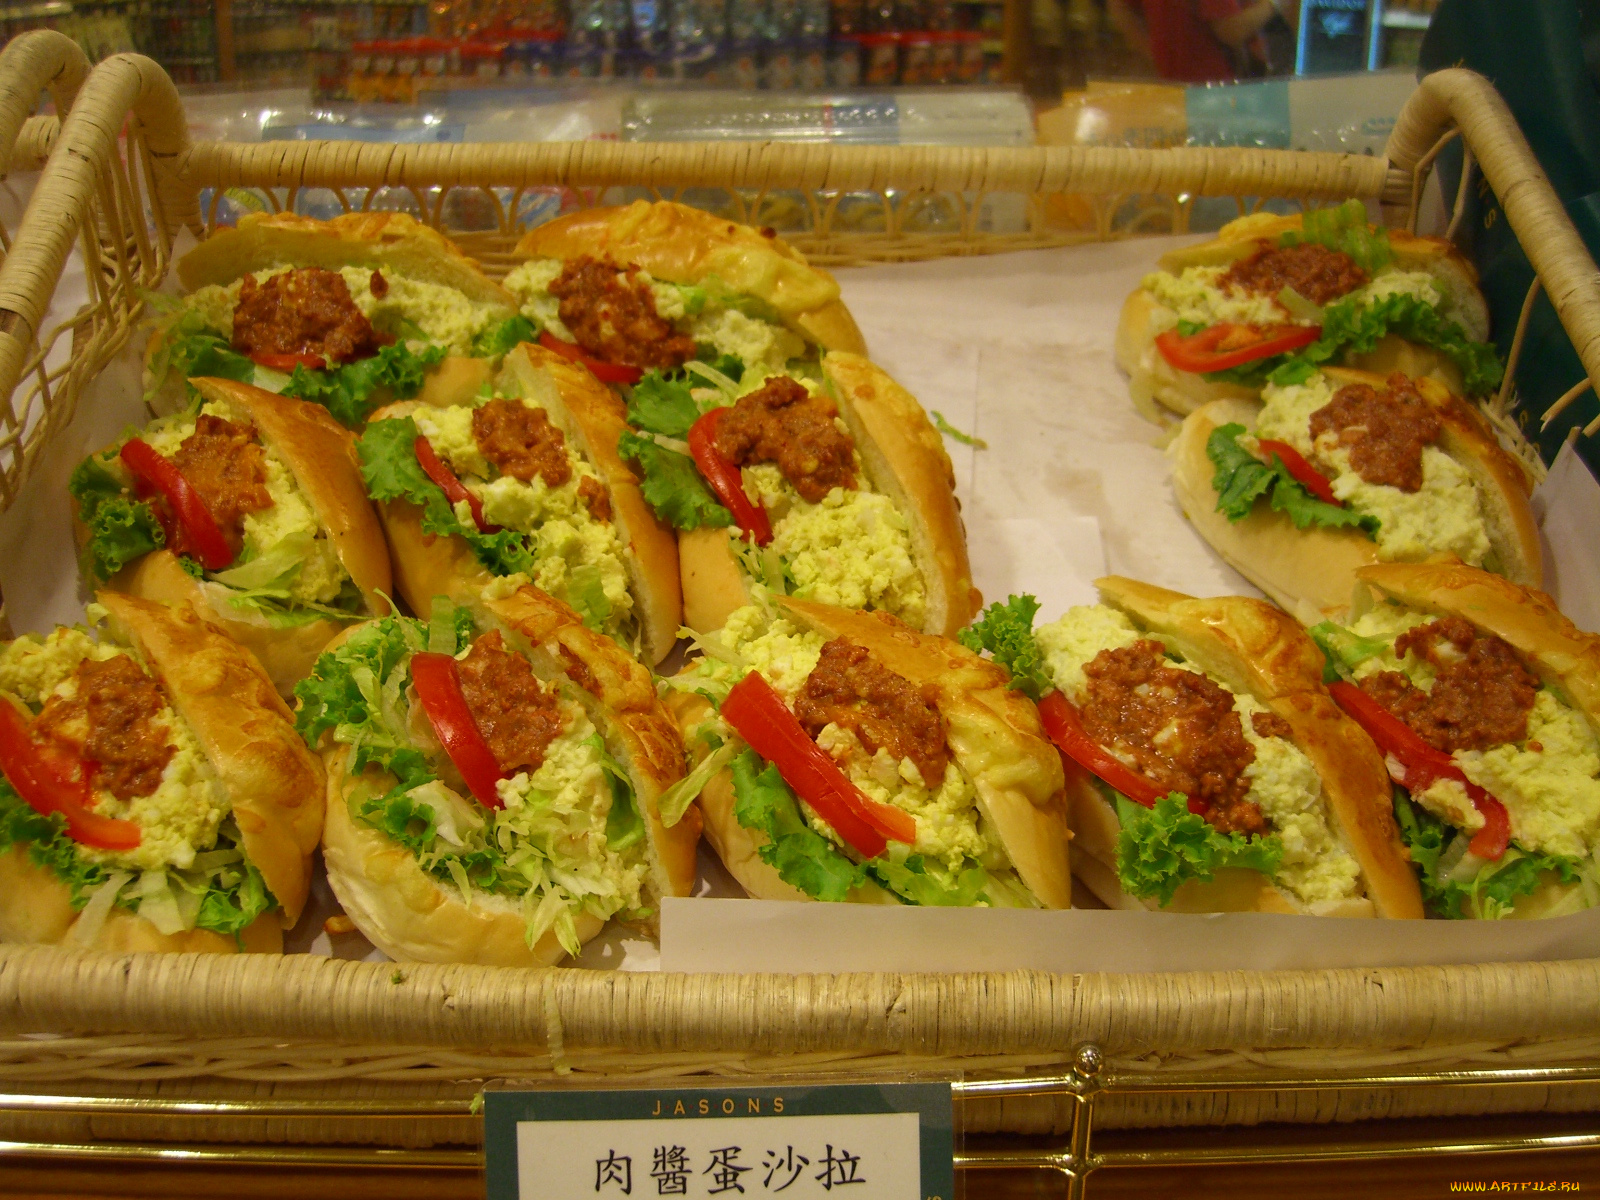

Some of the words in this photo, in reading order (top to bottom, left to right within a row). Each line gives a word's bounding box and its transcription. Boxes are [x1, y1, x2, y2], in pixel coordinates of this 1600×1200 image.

[652, 1097, 784, 1116] JASONS
[594, 1143, 867, 1196] 肉醬蛋沙拉
